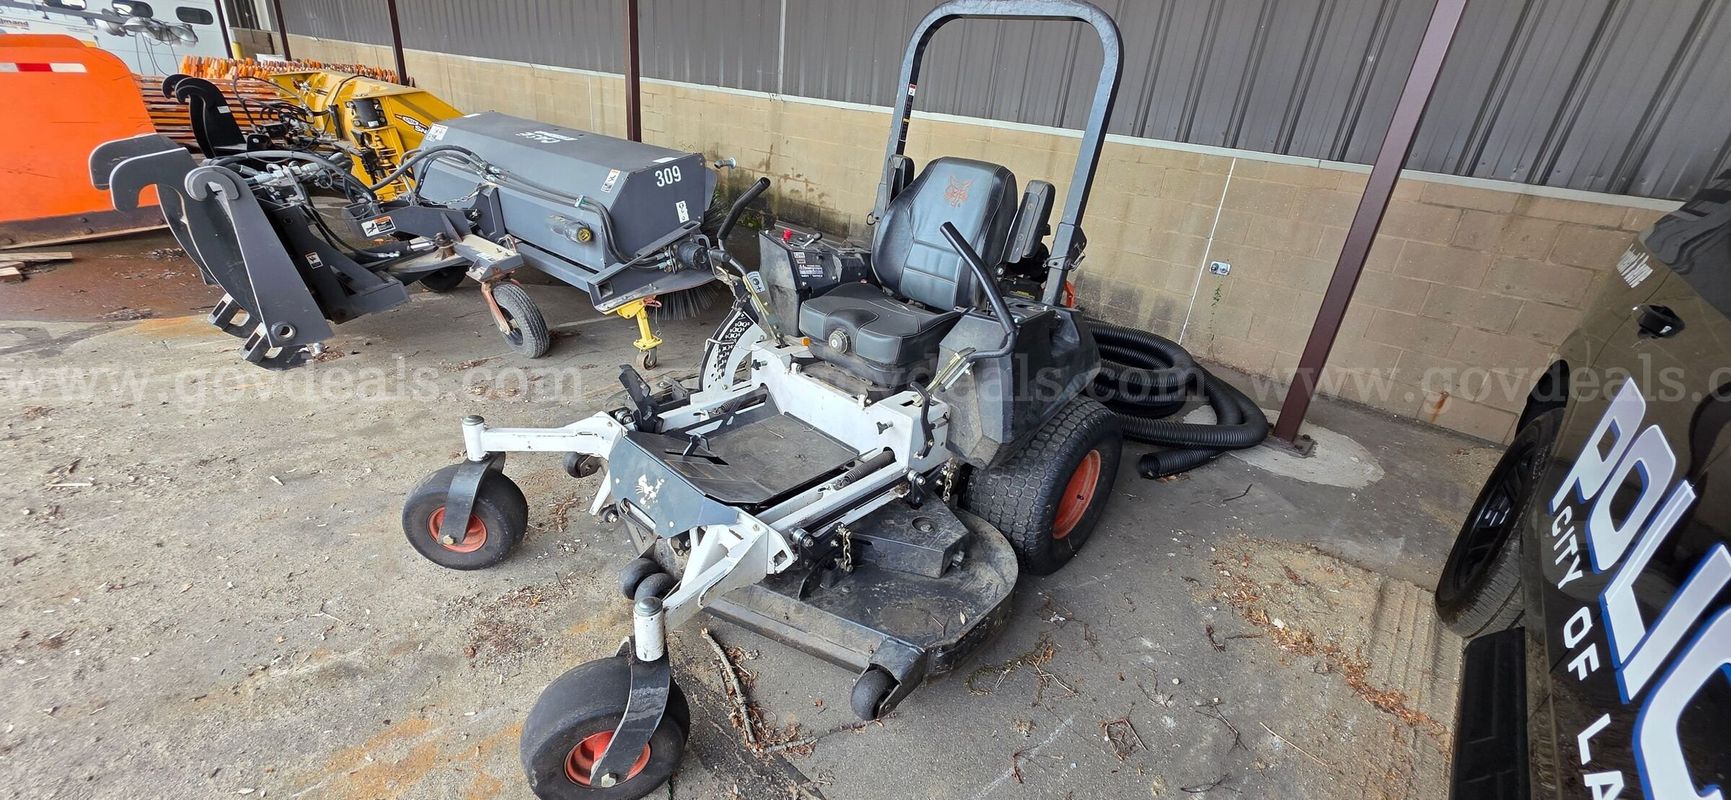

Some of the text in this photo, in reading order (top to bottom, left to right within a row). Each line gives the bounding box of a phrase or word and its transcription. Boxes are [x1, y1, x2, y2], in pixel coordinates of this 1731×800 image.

[655, 165, 682, 187] 309
[1552, 505, 1584, 589] CITY
[1563, 606, 1600, 681] OF
